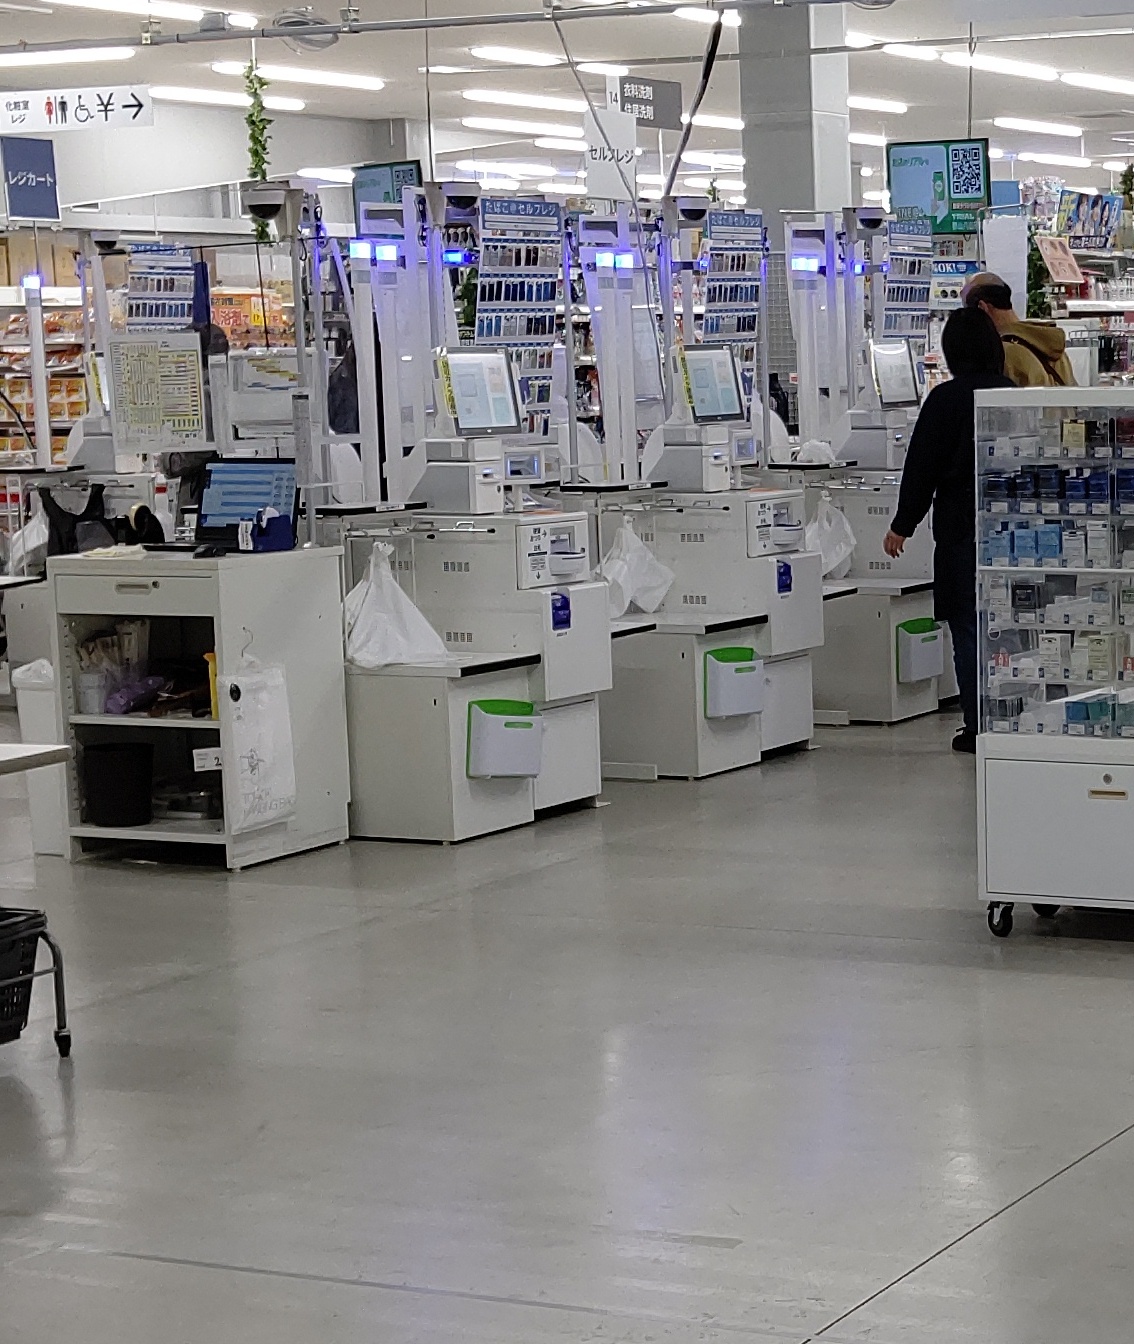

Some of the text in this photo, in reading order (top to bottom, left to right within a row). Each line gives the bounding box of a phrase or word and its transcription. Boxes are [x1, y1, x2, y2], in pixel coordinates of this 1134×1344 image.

[608, 91, 619, 105] 14
[5, 100, 30, 112] 化粧室
[11, 114, 26, 124] レジ
[588, 144, 634, 164] セルフレジ
[7, 170, 54, 188] レジカート
[213, 756, 222, 767] 2
